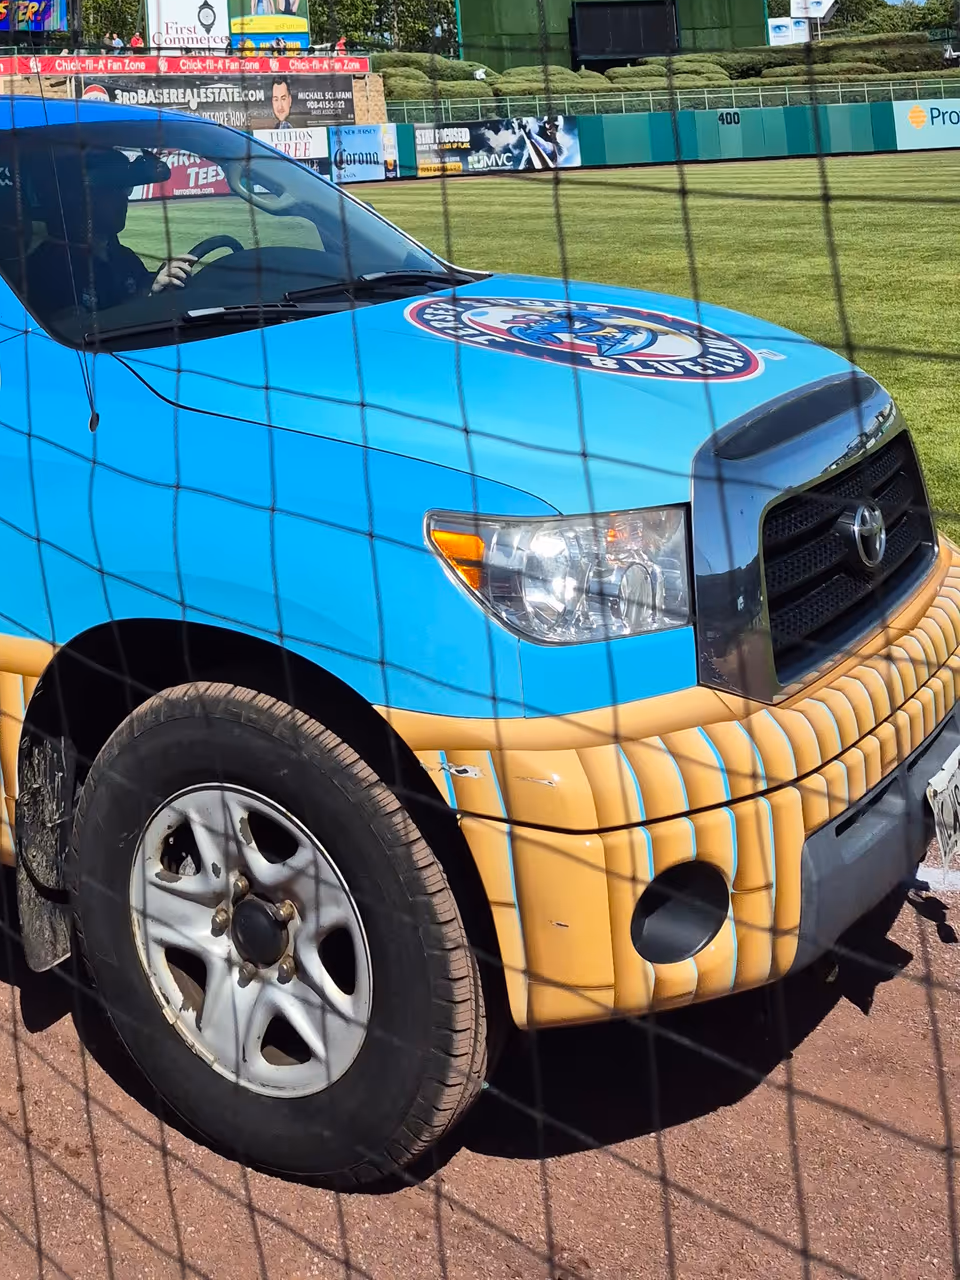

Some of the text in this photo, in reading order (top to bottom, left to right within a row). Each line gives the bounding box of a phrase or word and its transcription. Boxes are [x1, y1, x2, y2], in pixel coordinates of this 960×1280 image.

[164, 21, 197, 35] First
[152, 32, 227, 46] Commerce
[107, 60, 123, 70] Fan
[124, 60, 146, 70] Zone
[225, 60, 239, 70] Fan
[239, 60, 260, 70] Zone
[330, 60, 343, 70] Fan
[297, 91, 324, 100] MICHAEL
[230, 111, 251, 127] HOME
[718, 111, 741, 125] 400
[930, 106, 960, 126] Pro
[269, 130, 313, 142] TUITION
[343, 128, 356, 136] NEW
[415, 127, 470, 144] STAY FOCUSED
[333, 148, 380, 171] Corona
[187, 165, 226, 187] TEES
